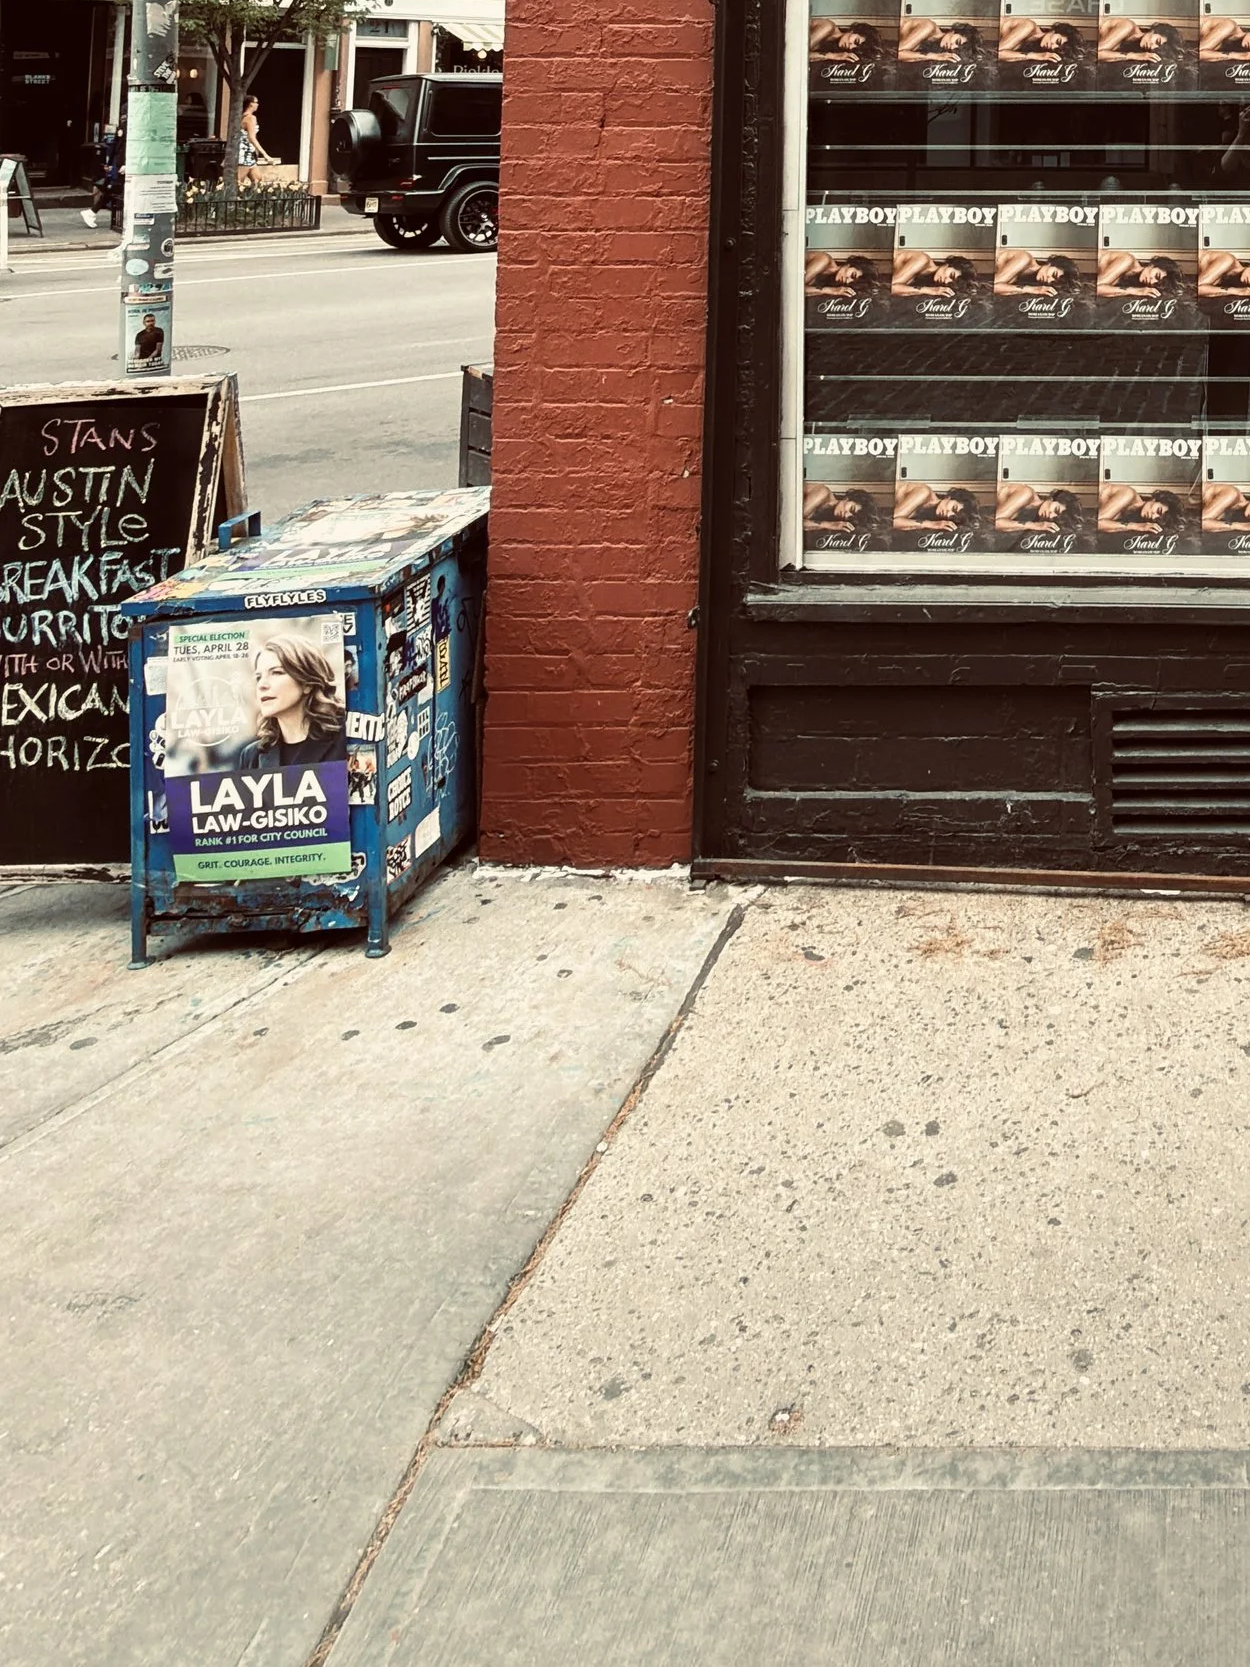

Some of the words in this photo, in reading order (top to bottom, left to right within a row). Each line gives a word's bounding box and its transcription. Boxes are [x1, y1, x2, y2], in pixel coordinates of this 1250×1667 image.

[806, 207, 897, 225] PLAYBOY
[899, 207, 997, 225] PLAYBOY
[1000, 207, 1098, 225] PLAYBOY
[1101, 207, 1199, 225] PLAYBOY
[41, 418, 160, 456] STANS
[803, 437, 898, 456] PLAYBOY
[900, 437, 999, 456] PLAYBOY
[1002, 437, 1100, 456] PLAYBOY
[1105, 437, 1201, 456] PLAYBOY
[0, 458, 155, 513] AUSTIN
[0, 547, 181, 605] REAKFAST
[246, 590, 326, 607] FLYFLYLES
[179, 634, 207, 643] SPECIAL
[209, 632, 245, 641] ELECTION
[203, 643, 233, 653] APRIL
[236, 641, 249, 651] 28
[46, 653, 75, 675] OR
[170, 705, 249, 730] LAYLA
[177, 725, 240, 739] LAW-GISIKO
[190, 769, 327, 814] LAYLA
[192, 805, 328, 834] LAW-GISIKO
[195, 837, 222, 847] RANK
[238, 834, 259, 843] FOR
[260, 832, 282, 842] CITY
[283, 828, 328, 839] COUNCIL
[198, 860, 222, 870] GRIT.
[223, 857, 273, 869] COURAGE.
[274, 852, 326, 865] INTEGRITY.
